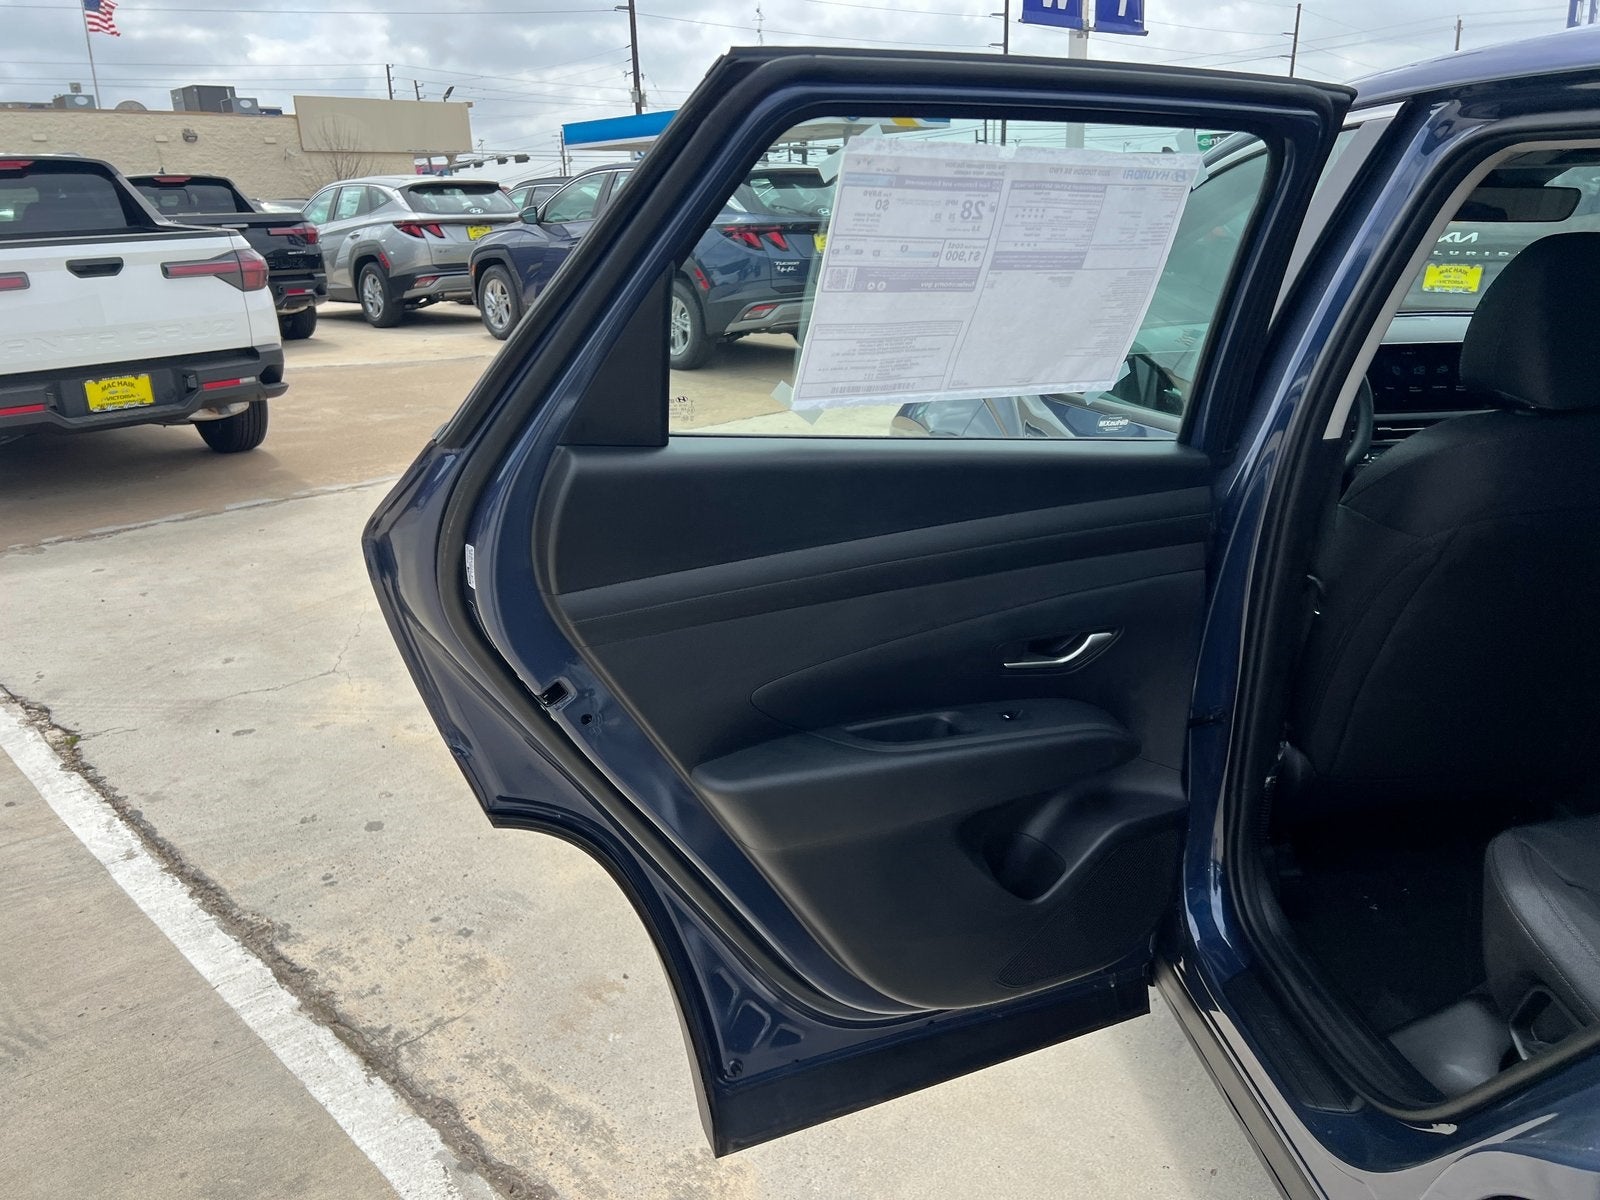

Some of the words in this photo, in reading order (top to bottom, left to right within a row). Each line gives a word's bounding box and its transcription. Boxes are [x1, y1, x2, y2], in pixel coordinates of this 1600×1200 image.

[1197, 136, 1226, 147] ent
[1439, 267, 1453, 275] MAC
[1453, 268, 1469, 276] HAIK
[101, 381, 117, 392] MAC
[117, 380, 136, 389] HAIK
[105, 393, 135, 402] VICTORIA
